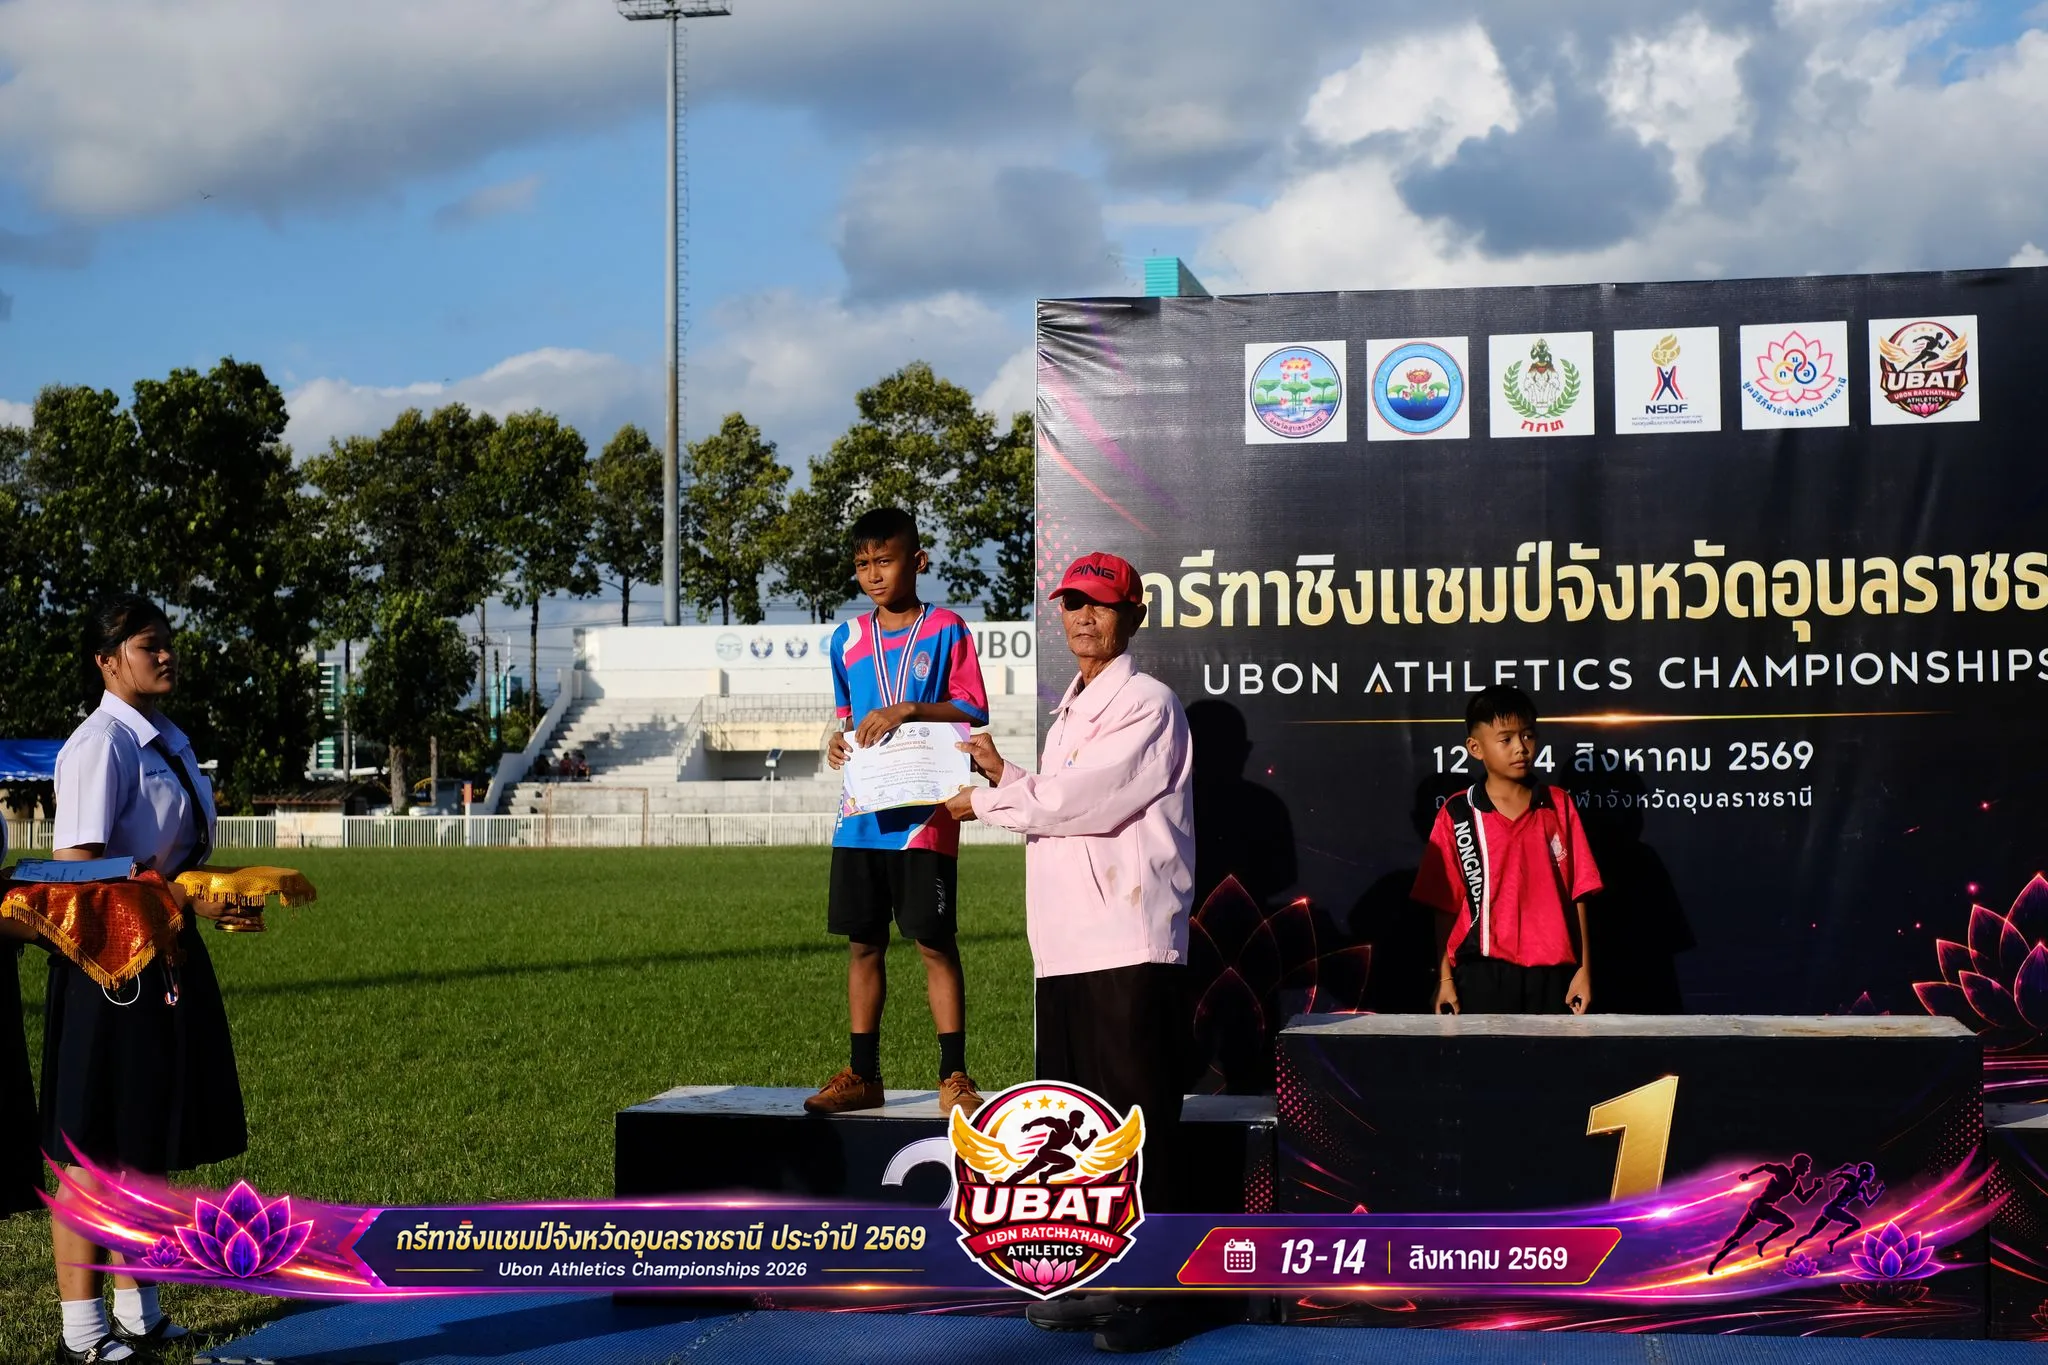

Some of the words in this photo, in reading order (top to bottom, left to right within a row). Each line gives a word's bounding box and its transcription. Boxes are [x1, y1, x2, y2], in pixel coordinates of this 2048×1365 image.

[1887, 370, 1961, 391] UBAT
[1645, 404, 1688, 414] NSDF
[1070, 563, 1116, 581] PING
[1204, 662, 1338, 695] UBON
[1363, 657, 1633, 693] ATHLETICS
[1433, 745, 1468, 774] 12
[1574, 741, 1712, 773] สิงหาคม
[1728, 740, 1814, 772] 2569
[1454, 820, 1483, 903] NONGMU
[1586, 1076, 1679, 1203] 1
